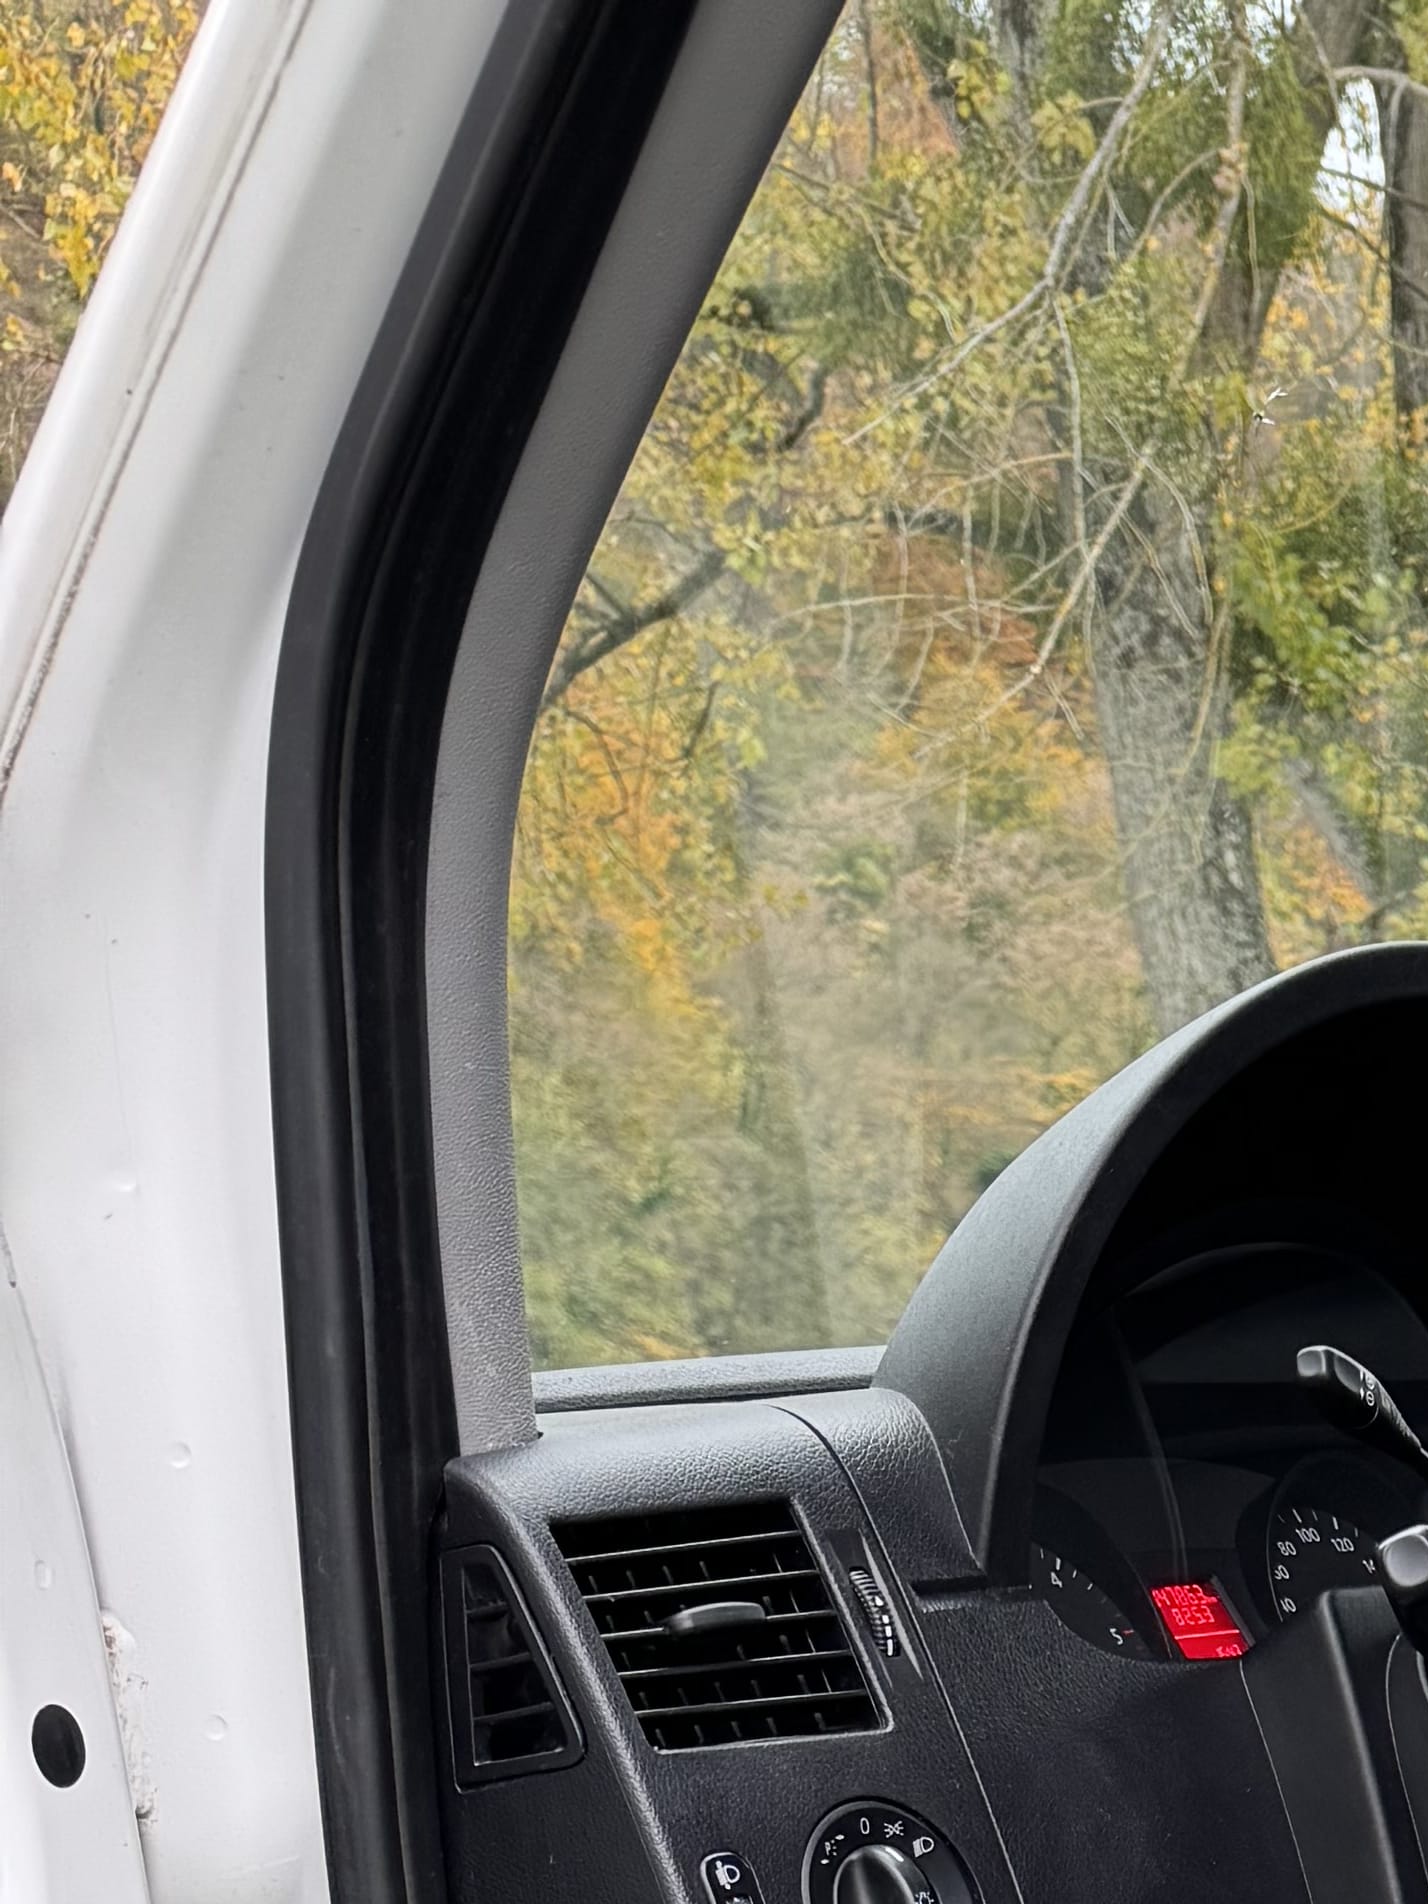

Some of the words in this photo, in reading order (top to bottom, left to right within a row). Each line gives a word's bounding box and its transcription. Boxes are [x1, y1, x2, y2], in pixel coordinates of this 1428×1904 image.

[1295, 1527, 1320, 1543] 100
[1277, 1541, 1296, 1556] 80
[1331, 1537, 1354, 1552] 120
[1051, 1571, 1062, 1588] 4
[1109, 1628, 1123, 1645] 5
[859, 1817, 870, 1835] 0
